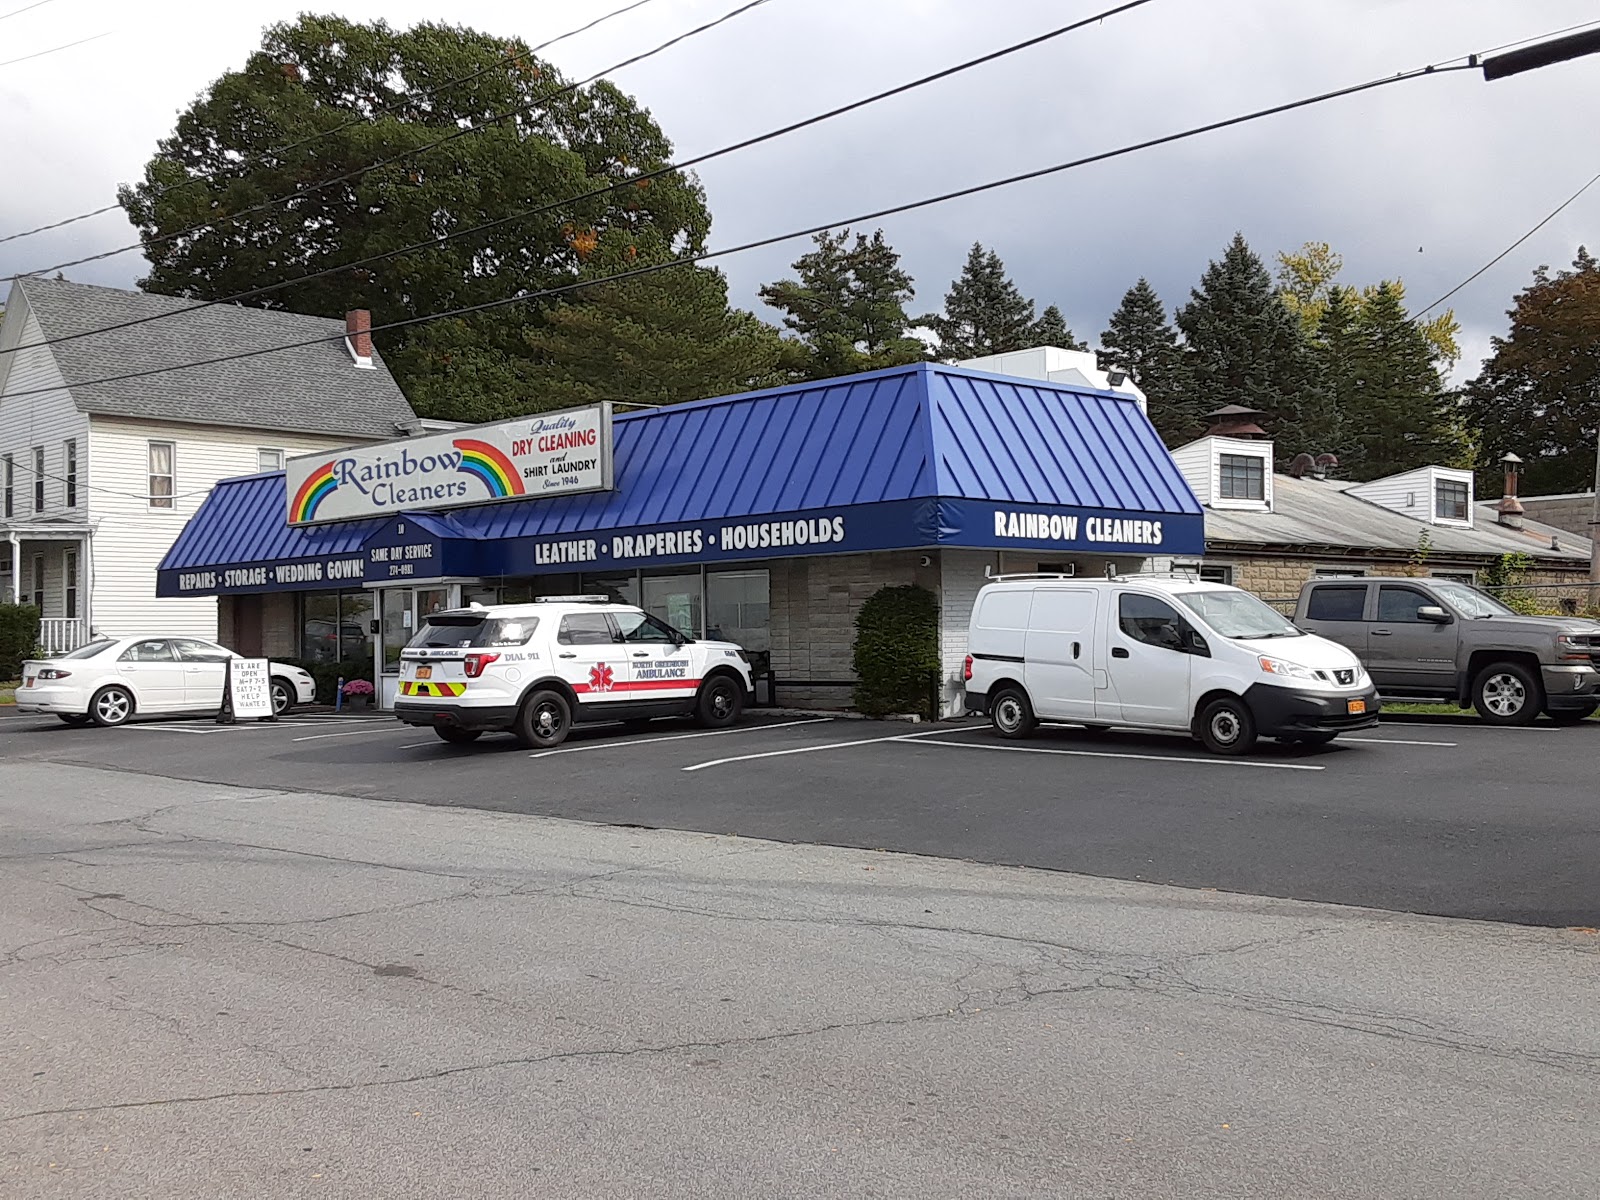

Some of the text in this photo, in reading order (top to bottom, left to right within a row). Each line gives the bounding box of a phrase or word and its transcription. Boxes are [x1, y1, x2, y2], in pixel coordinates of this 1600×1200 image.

[530, 416, 577, 435] Quality
[512, 428, 597, 457] DRY CLEANING
[549, 452, 568, 463] and
[333, 449, 461, 495] Rainbow
[523, 458, 597, 478] SHIRT LAUNDRY
[542, 475, 579, 490] Since 1946
[371, 481, 467, 506] Cleaners
[397, 523, 405, 535] 10
[994, 511, 1163, 545] RAINBOW CLEANERS
[534, 516, 845, 565] LEATHER DRAPERIES HOUSEHOLDS
[371, 543, 433, 563] SAME DAY SERVICE
[179, 571, 217, 591] REPAIRS
[224, 566, 267, 588] STORAGE
[275, 562, 323, 584] WEDDING
[504, 652, 540, 662] DIAL 911
[635, 668, 686, 680] AMBULANCE
